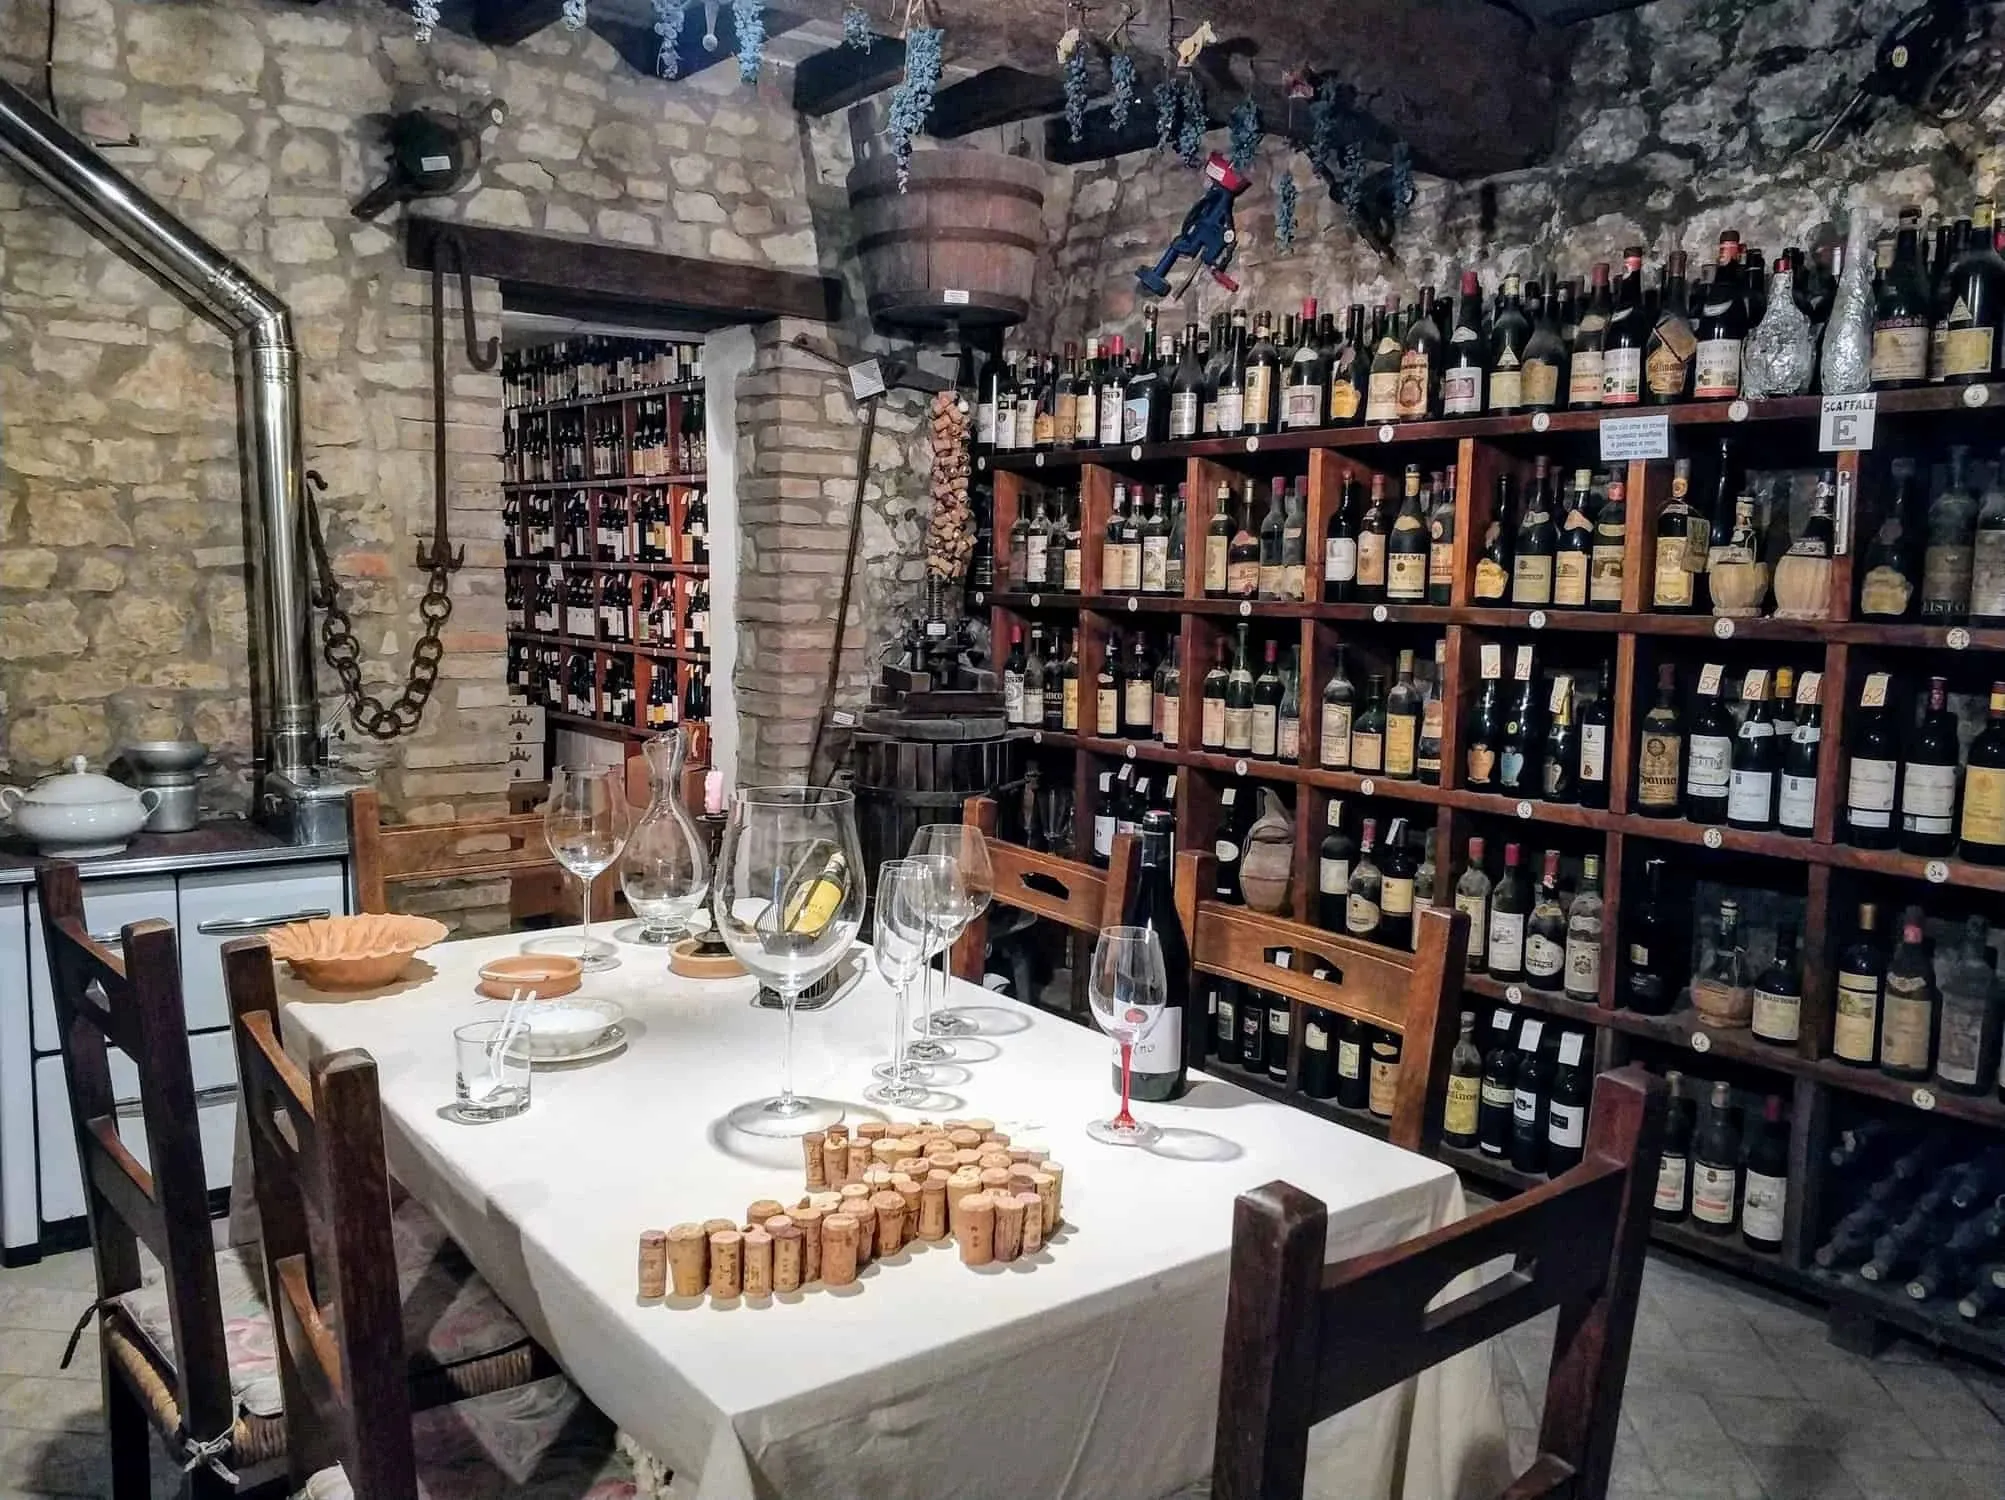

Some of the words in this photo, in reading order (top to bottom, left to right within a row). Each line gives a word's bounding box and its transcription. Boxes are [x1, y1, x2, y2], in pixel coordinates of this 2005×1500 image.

[1823, 400, 1874, 412] SCAFFALE
[1832, 415, 1857, 445] E
[1718, 623, 1730, 634] 20
[1744, 680, 1761, 697] 62
[1798, 686, 1816, 702] 62
